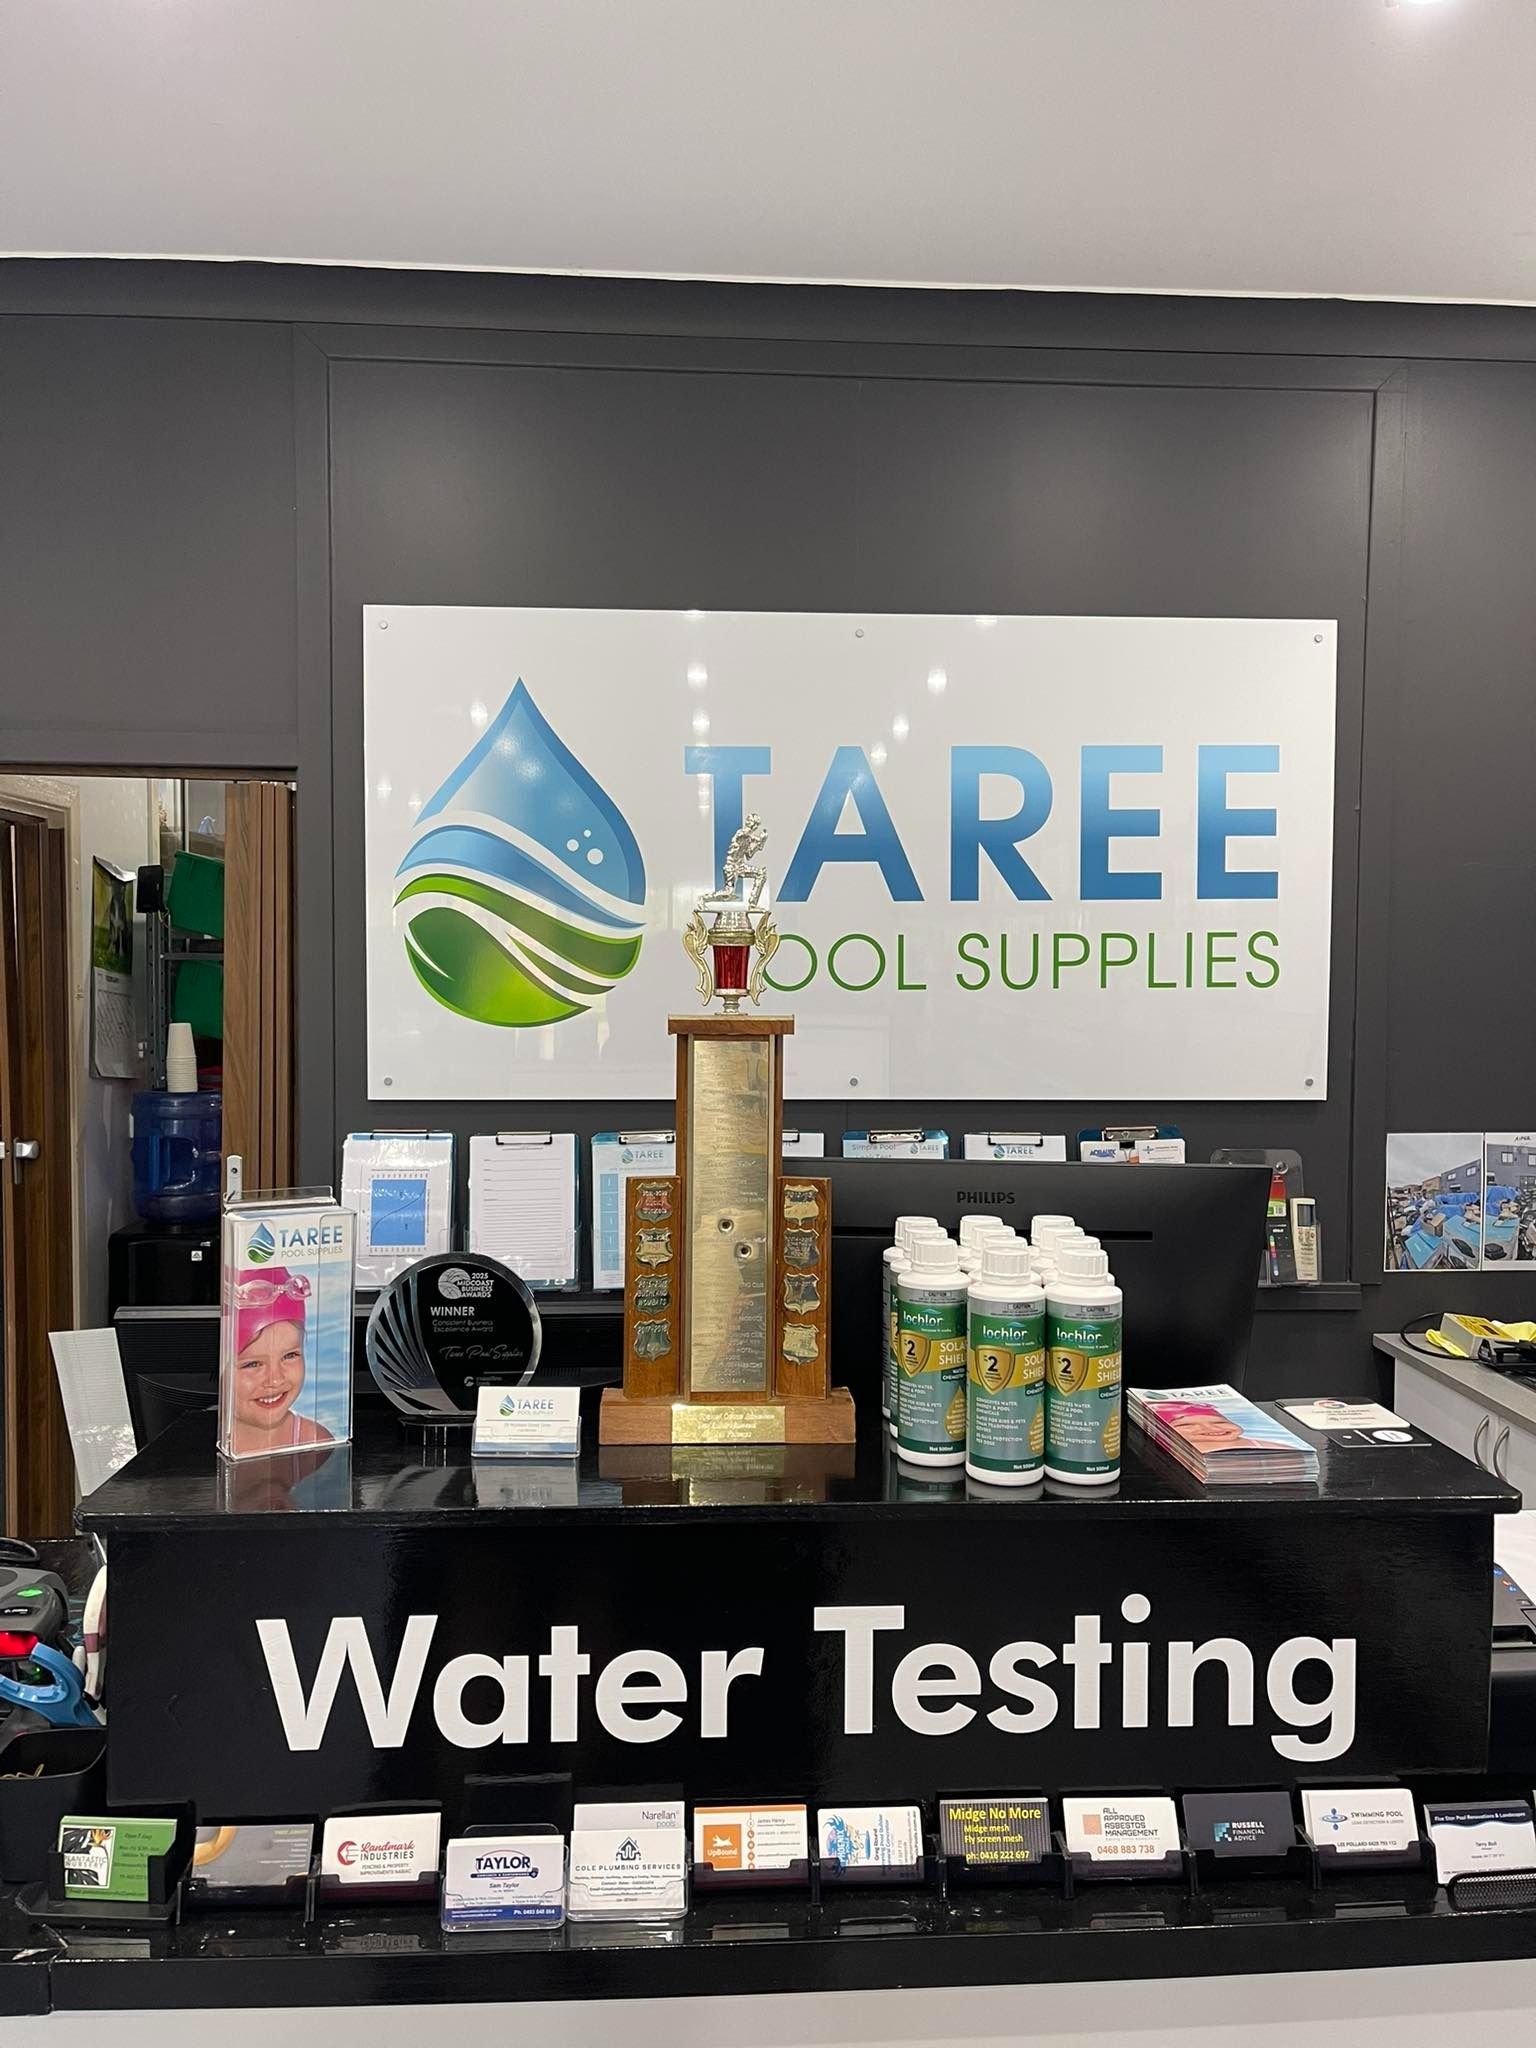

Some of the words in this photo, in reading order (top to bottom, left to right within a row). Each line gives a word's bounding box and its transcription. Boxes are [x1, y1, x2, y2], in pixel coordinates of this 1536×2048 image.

[684, 745, 1280, 902] TAREE
[763, 933, 927, 992] OOL
[957, 930, 1280, 991] SUPPLIES
[635, 1150, 664, 1159] TAREE
[1006, 1146, 1034, 1155] TAREE
[956, 1191, 1016, 1204] PHILIPS
[280, 1225, 343, 1248] TAREE
[281, 1249, 305, 1258] POOL
[307, 1246, 343, 1256] SUPPLIES
[471, 1272, 489, 1280] 2025
[430, 1306, 475, 1317] WINNER
[903, 1310, 944, 1326] lochlor
[983, 1325, 1028, 1341] lochlor
[1056, 1327, 1102, 1343] lochlor
[906, 1340, 916, 1356] 2
[940, 1342, 966, 1353] SOLA
[938, 1354, 966, 1365] SHIEL
[987, 1355, 998, 1372] 2
[1060, 1357, 1072, 1374] 2
[1169, 1388, 1229, 1398] TAREE
[516, 1399, 554, 1410] TAREE
[255, 1614, 766, 1752] Water
[813, 1593, 1357, 1763] Testing
[642, 1810, 677, 1820] Narellan
[949, 1808, 987, 1822] Midge
[989, 1807, 1006, 1819] No
[1009, 1807, 1042, 1819] More
[1103, 1807, 1118, 1815] ALL
[657, 1820, 676, 1829] pools
[964, 1824, 988, 1834] Midge
[989, 1823, 1010, 1832] mesh
[1104, 1821, 1146, 1829] ASBESTOS
[1105, 1829, 1158, 1837] MANAGEMENT
[964, 1835, 975, 1845] Fly
[976, 1835, 1001, 1843] screen
[1003, 1834, 1024, 1843] mesh
[360, 1840, 415, 1852] Landmark
[836, 1828, 848, 1864] PHOENIX
[1097, 1845, 1119, 1854] 0468
[1120, 1845, 1137, 1854] 883
[1139, 1844, 1155, 1854] 738
[360, 1851, 414, 1861] INDUSTRIES
[707, 1848, 738, 1858] UpBound
[966, 1852, 978, 1861] ph:
[979, 1851, 999, 1860] 0416
[1000, 1851, 1014, 1859] 222
[1015, 1850, 1030, 1859] 697
[475, 1856, 530, 1870] TAYLOR
[575, 1864, 597, 1872] COLE
[600, 1863, 640, 1871] PLUMBING
[642, 1863, 681, 1871] SERVICES
[503, 1881, 520, 1890] Taylor
